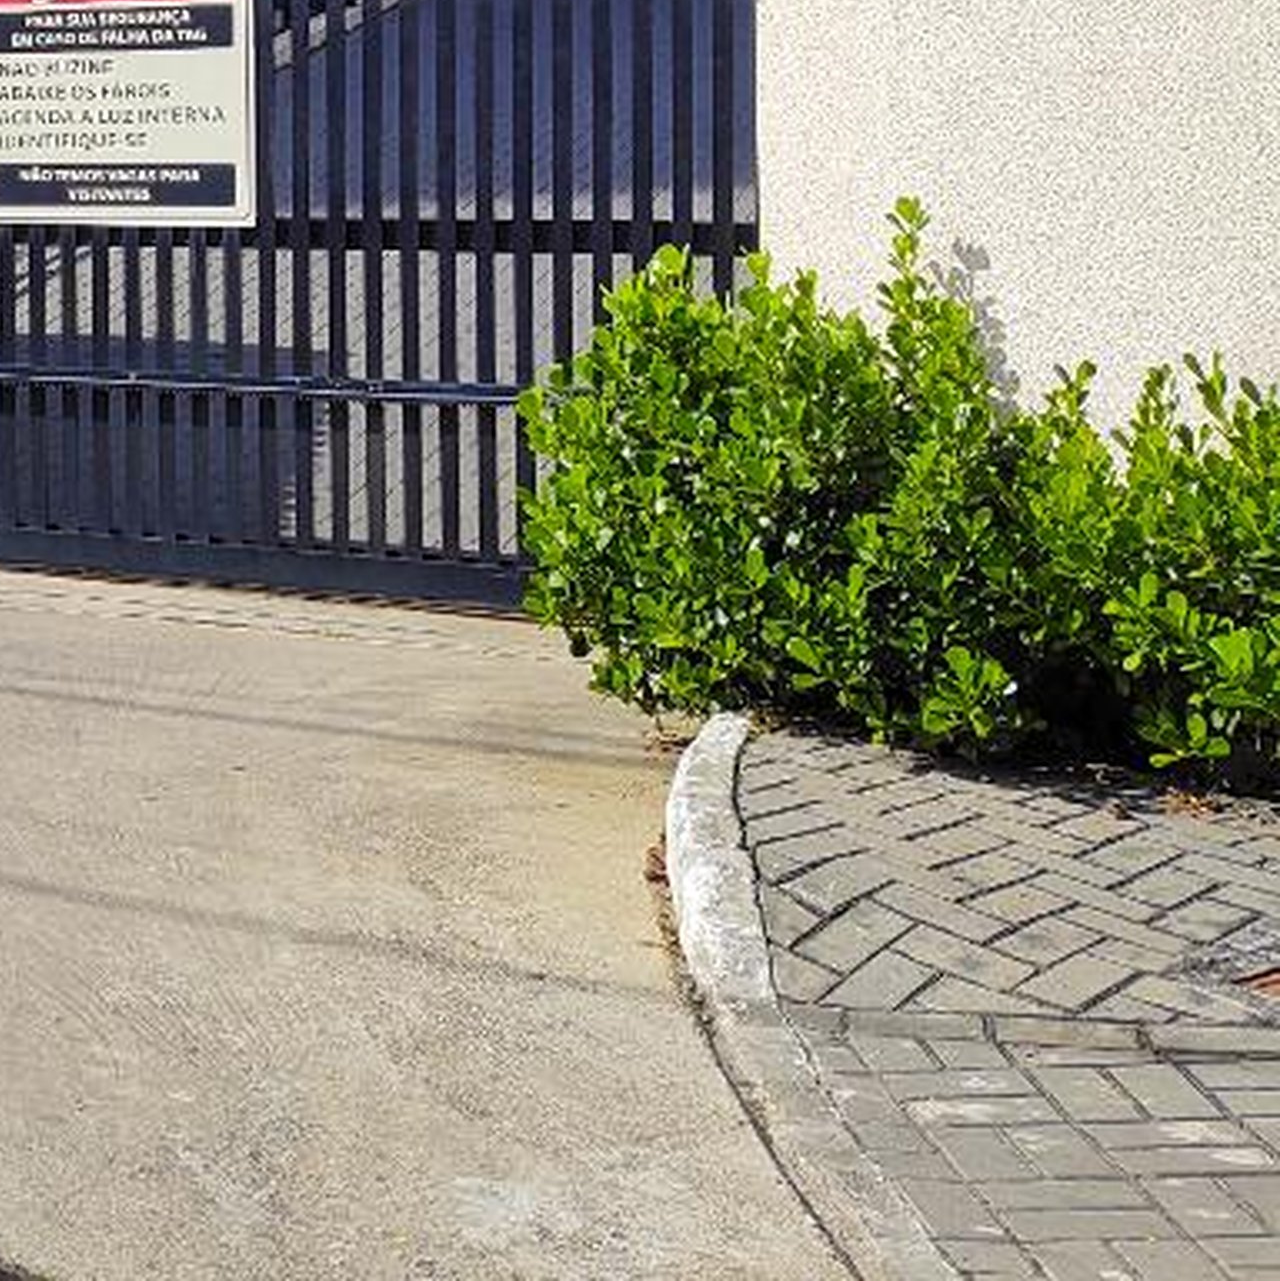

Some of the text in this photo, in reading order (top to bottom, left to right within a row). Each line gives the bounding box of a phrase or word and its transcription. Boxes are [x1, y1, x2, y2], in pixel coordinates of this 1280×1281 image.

[66, 12, 96, 27] SUA
[10, 32, 33, 48] EM
[78, 31, 99, 45] DE
[101, 29, 149, 45] FALHA
[151, 28, 173, 43] DA
[71, 85, 97, 100] OS
[79, 109, 93, 124] A
[98, 108, 134, 124] LUZ
[137, 105, 226, 124] INTERNA
